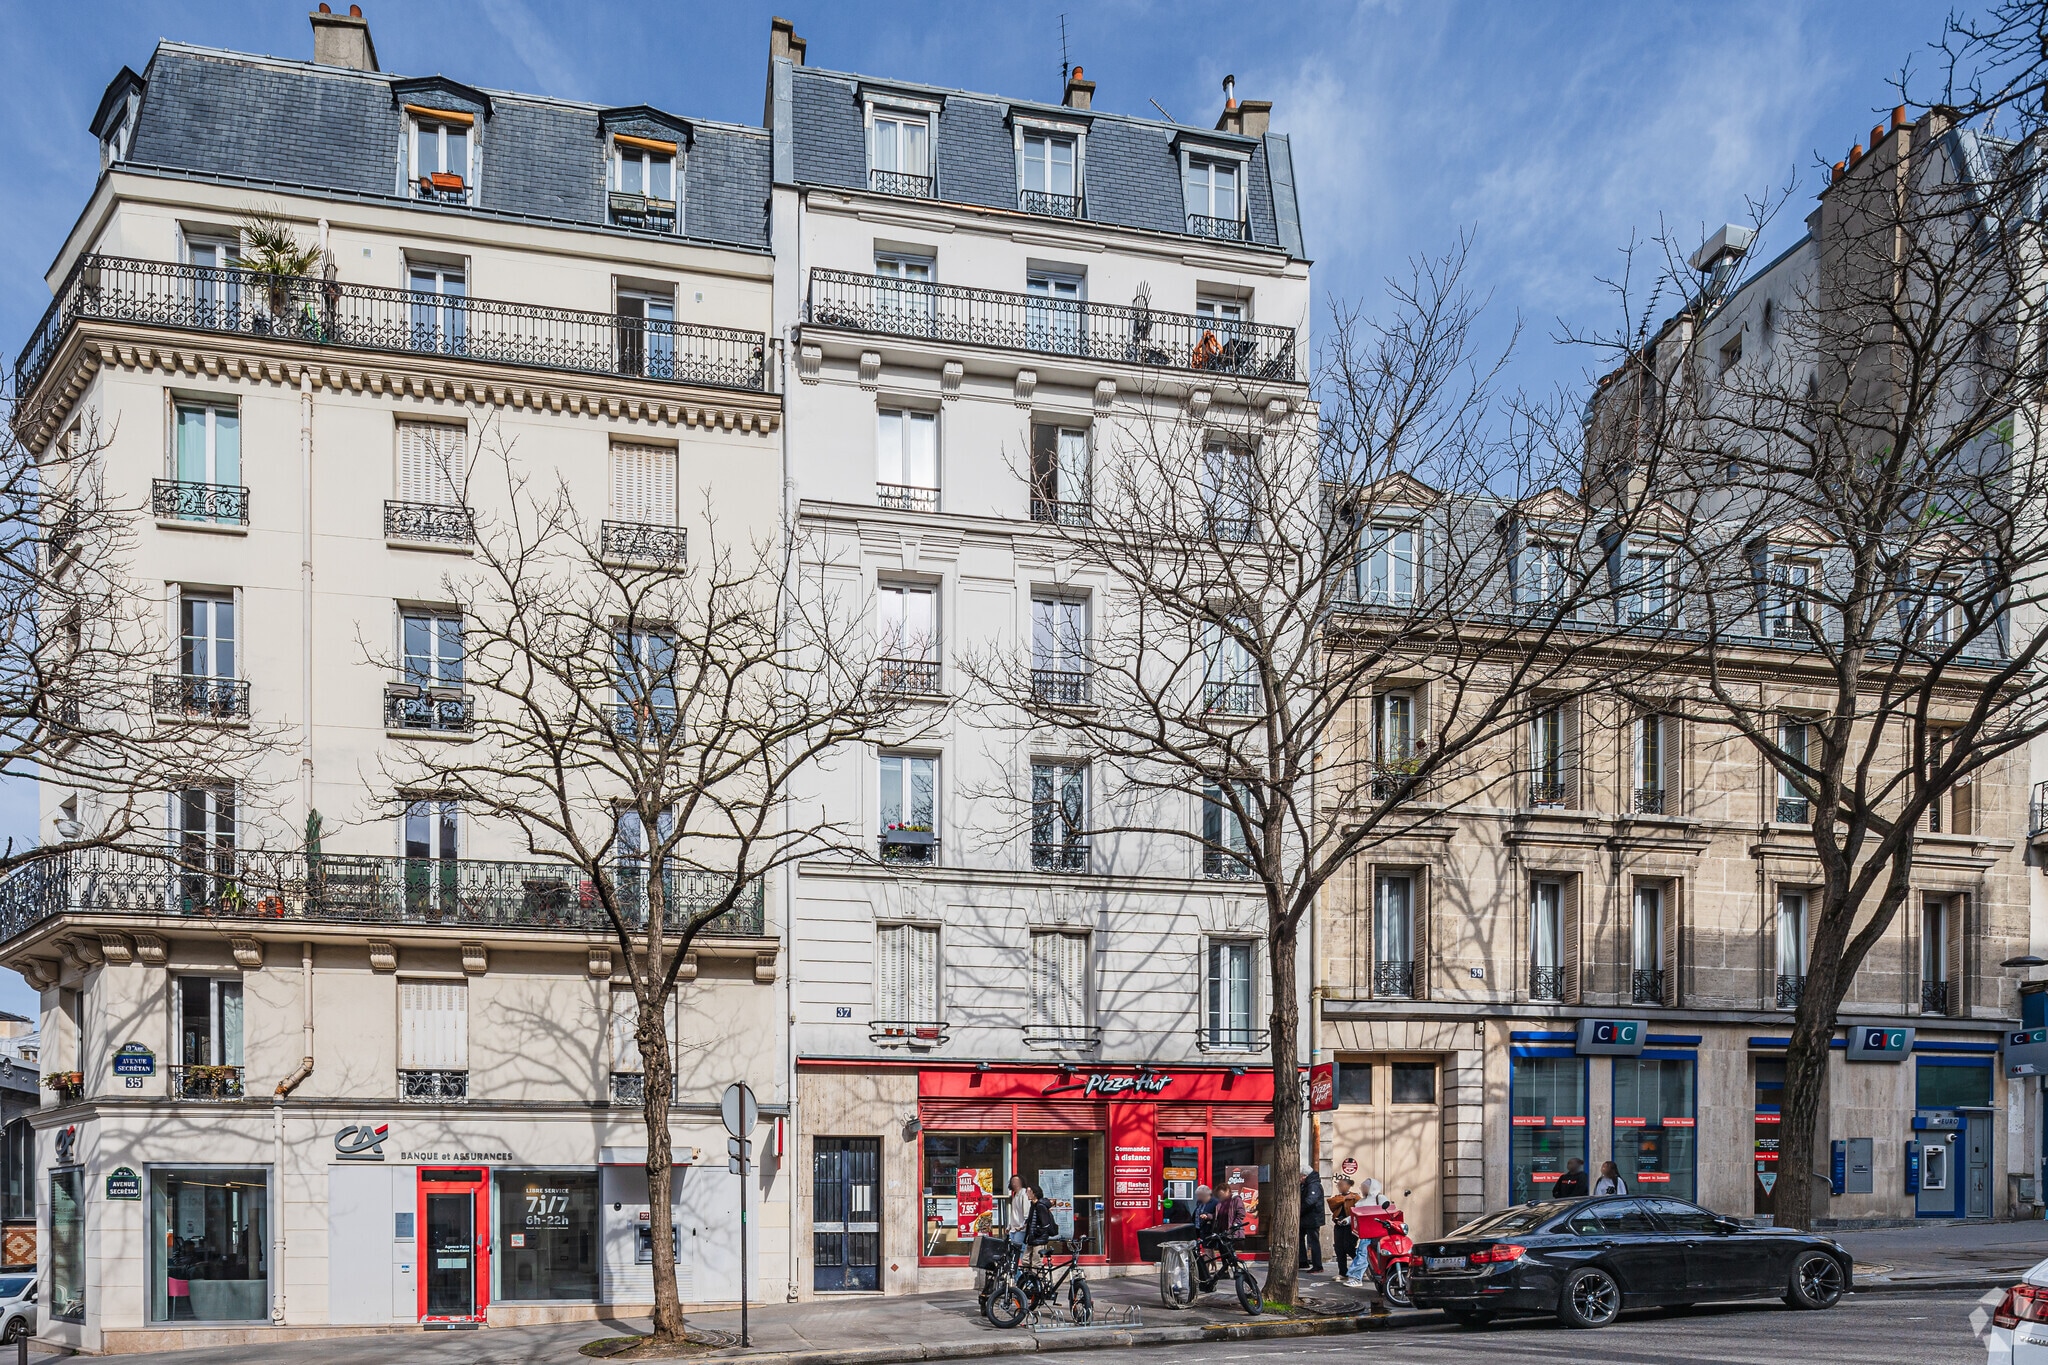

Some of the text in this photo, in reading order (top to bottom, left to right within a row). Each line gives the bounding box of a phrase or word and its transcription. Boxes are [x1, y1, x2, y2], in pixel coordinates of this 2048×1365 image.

[1472, 969, 1482, 978] 39
[838, 1008, 850, 1017] 37
[1598, 1026, 1634, 1040] CIC
[2014, 1032, 2043, 1043] CIC
[1868, 1032, 1902, 1048] CIC
[127, 1077, 141, 1088] 35
[1085, 1074, 1173, 1095] Pizza Hut
[1312, 1083, 1330, 1098] Pizza
[1315, 1090, 1330, 1105] Hut
[401, 1152, 513, 1161] BANQUE et ASSURANCES
[526, 1195, 569, 1215] 7j/7
[526, 1215, 569, 1224] 6h-22h
